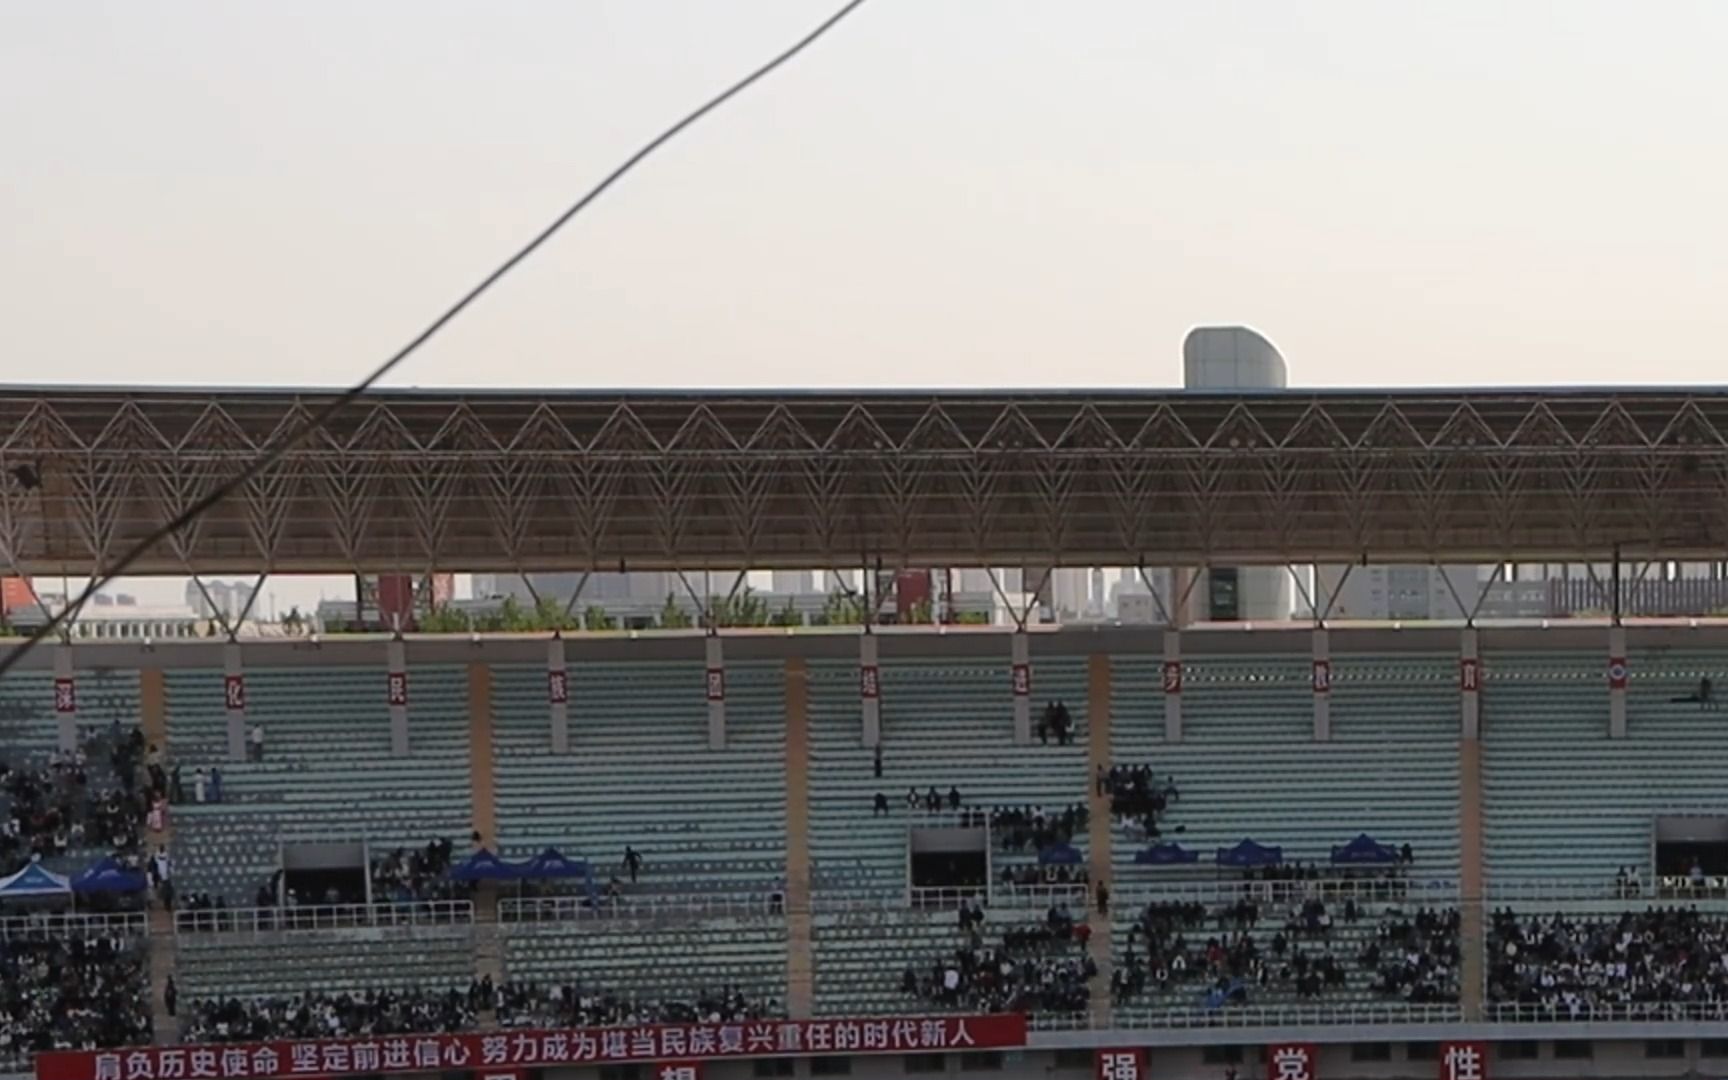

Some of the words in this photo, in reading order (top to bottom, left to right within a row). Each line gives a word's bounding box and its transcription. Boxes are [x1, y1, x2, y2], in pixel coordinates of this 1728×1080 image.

[291, 1036, 471, 1074] 坚定前进信心
[481, 1018, 975, 1064] 努力成为堪当民族复兴重任的时代新人
